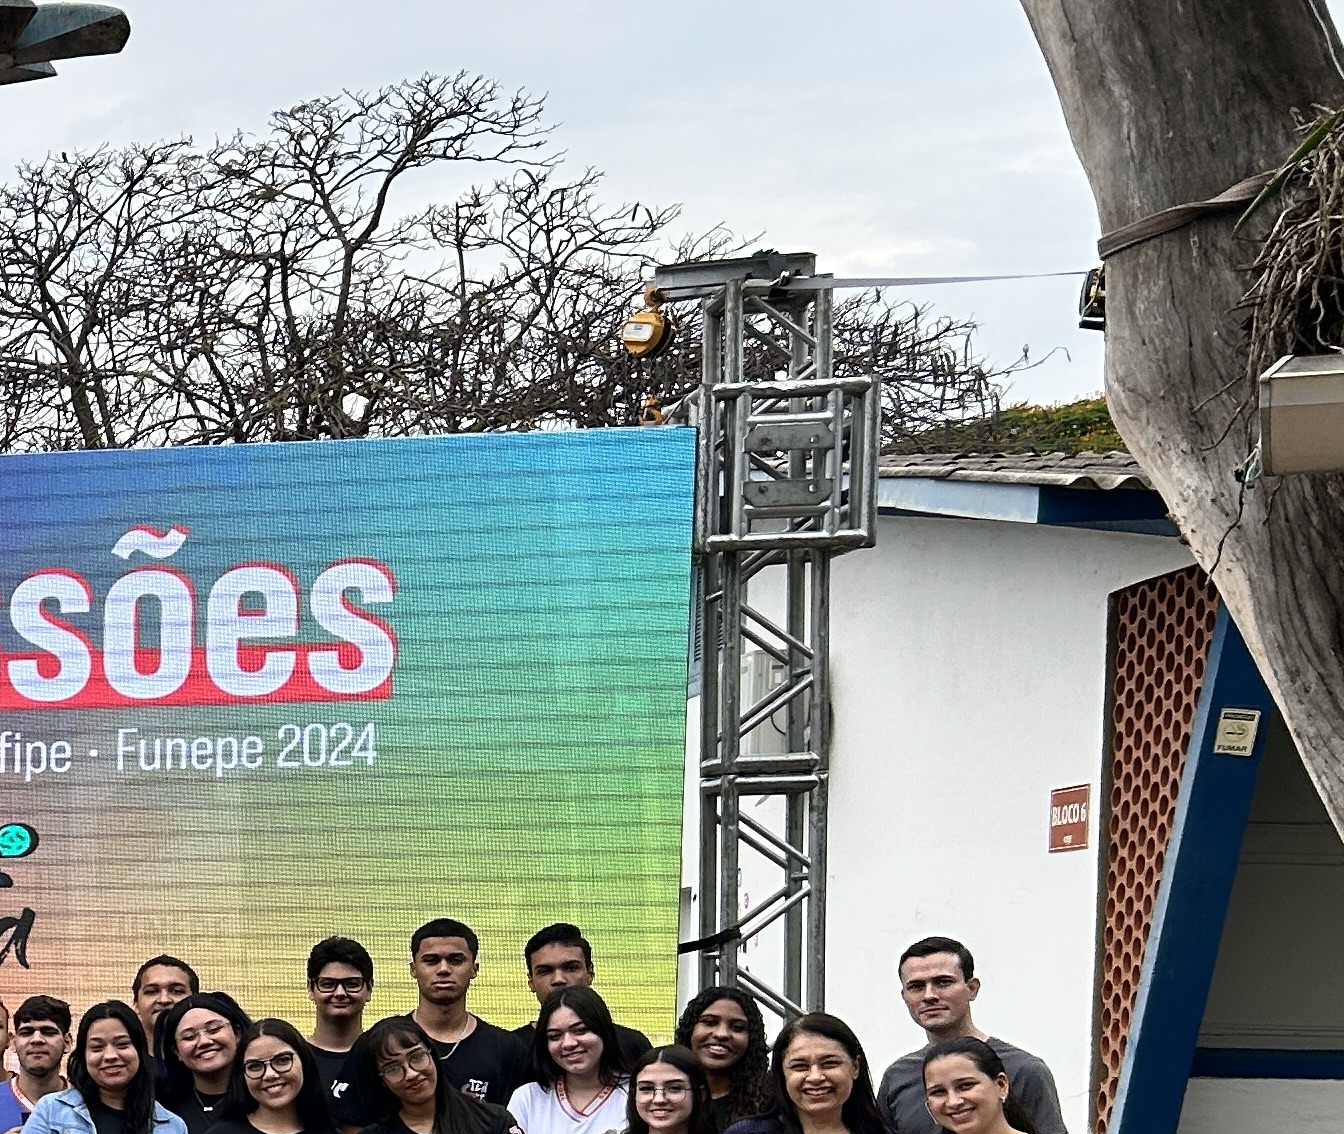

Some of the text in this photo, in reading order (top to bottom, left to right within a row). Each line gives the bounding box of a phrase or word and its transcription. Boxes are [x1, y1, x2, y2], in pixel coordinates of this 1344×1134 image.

[116, 727, 264, 778] Funepe
[277, 722, 378, 769] 2024
[1052, 802, 1087, 827] BLOCO 6
